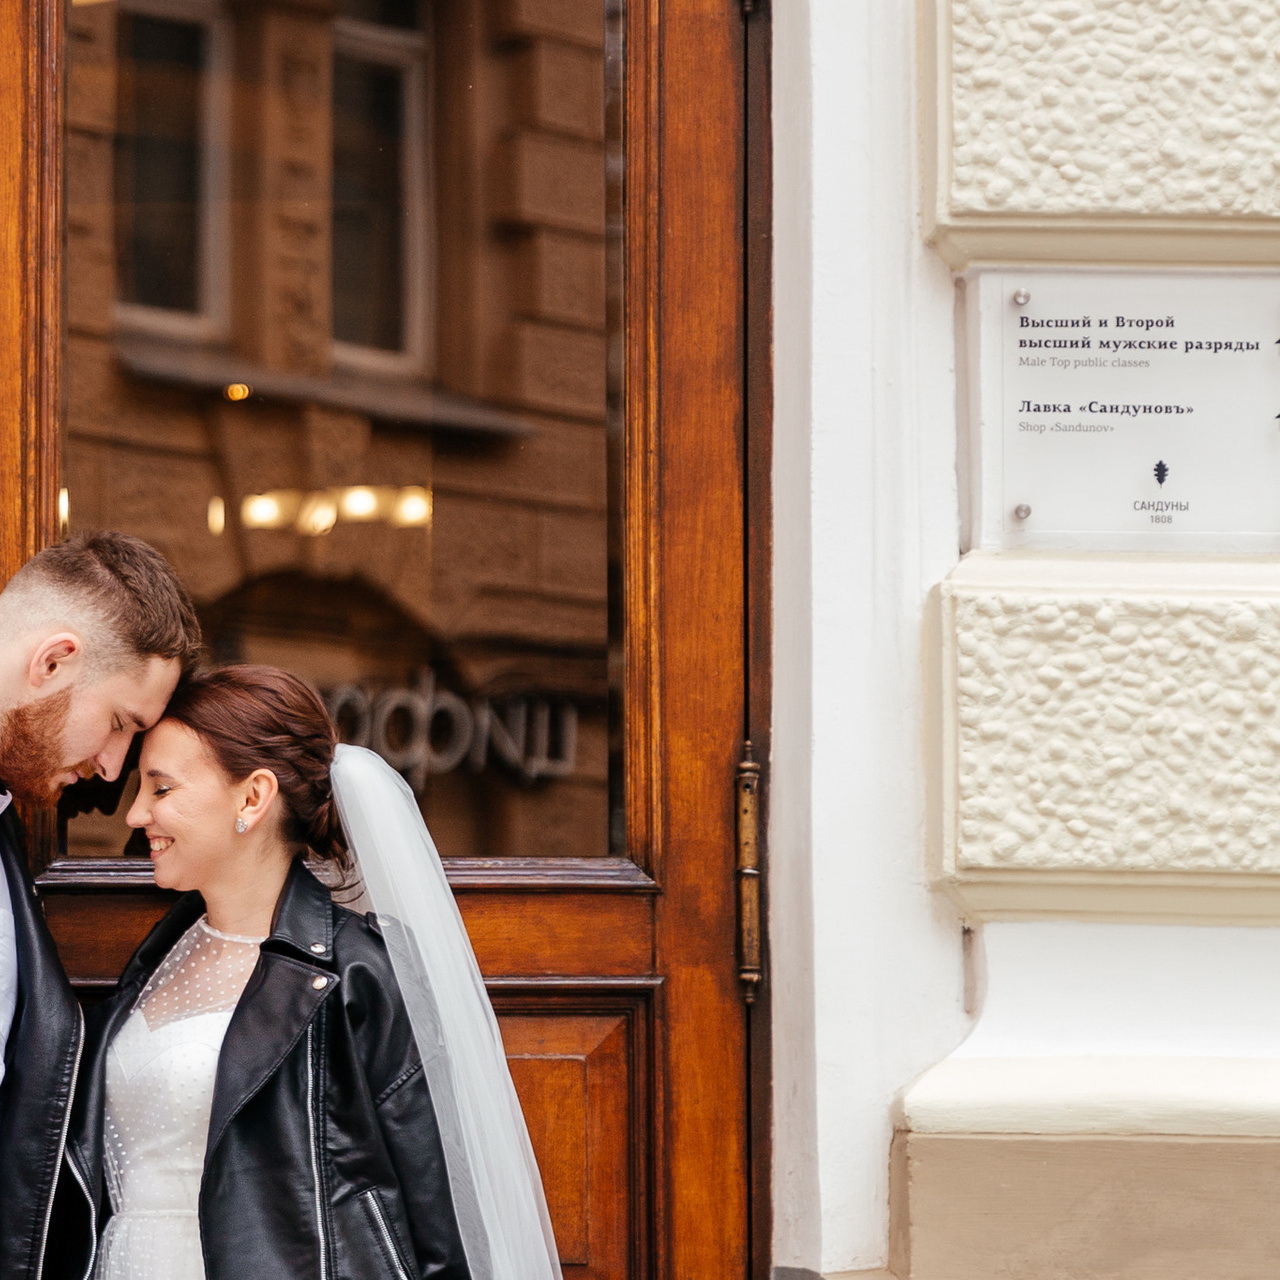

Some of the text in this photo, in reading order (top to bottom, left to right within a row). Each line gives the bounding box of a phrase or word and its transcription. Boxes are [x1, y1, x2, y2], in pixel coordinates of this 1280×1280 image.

[1019, 316, 1175, 331] Высший и Второй
[1019, 336, 1260, 354] высший мужские разряды
[1018, 356, 1150, 370] Male Top public classes
[1019, 400, 1194, 417] Лавка «Сандуновъ»
[1019, 421, 1115, 434] Shop «Sandunov»
[1133, 500, 1189, 513] САНДУНЫ
[1150, 514, 1173, 524] 1808
